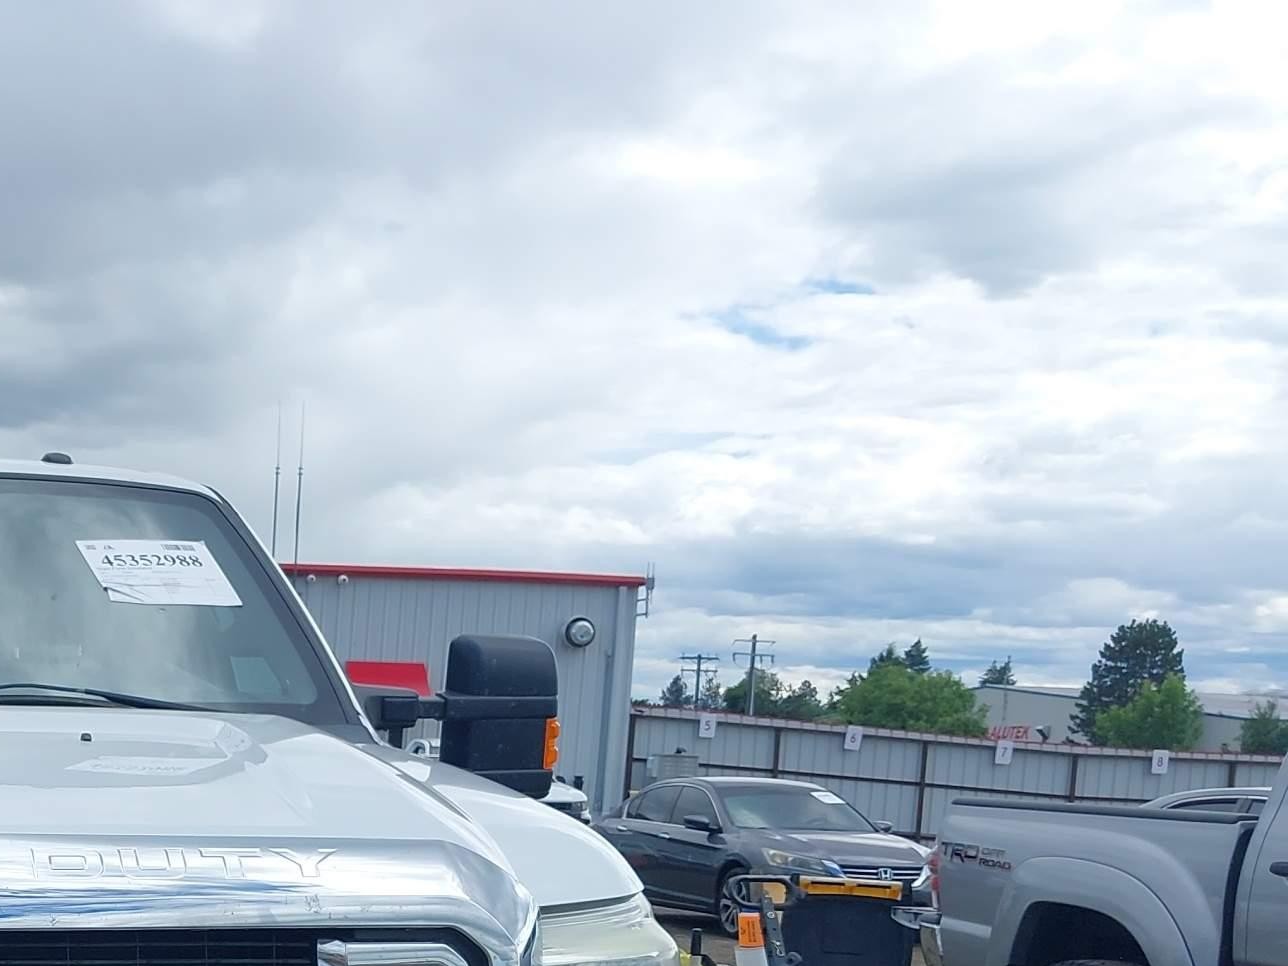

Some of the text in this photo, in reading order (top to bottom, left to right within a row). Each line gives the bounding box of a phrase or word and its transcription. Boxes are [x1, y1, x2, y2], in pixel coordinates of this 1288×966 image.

[102, 554, 204, 568] 45352988
[703, 719, 712, 731] 5
[849, 732, 857, 744] 6
[1000, 746, 1009, 758] 7
[1156, 757, 1164, 768] 8
[941, 841, 980, 863] TRD
[28, 845, 338, 882] DUTY
[978, 857, 1012, 871] ROAD
